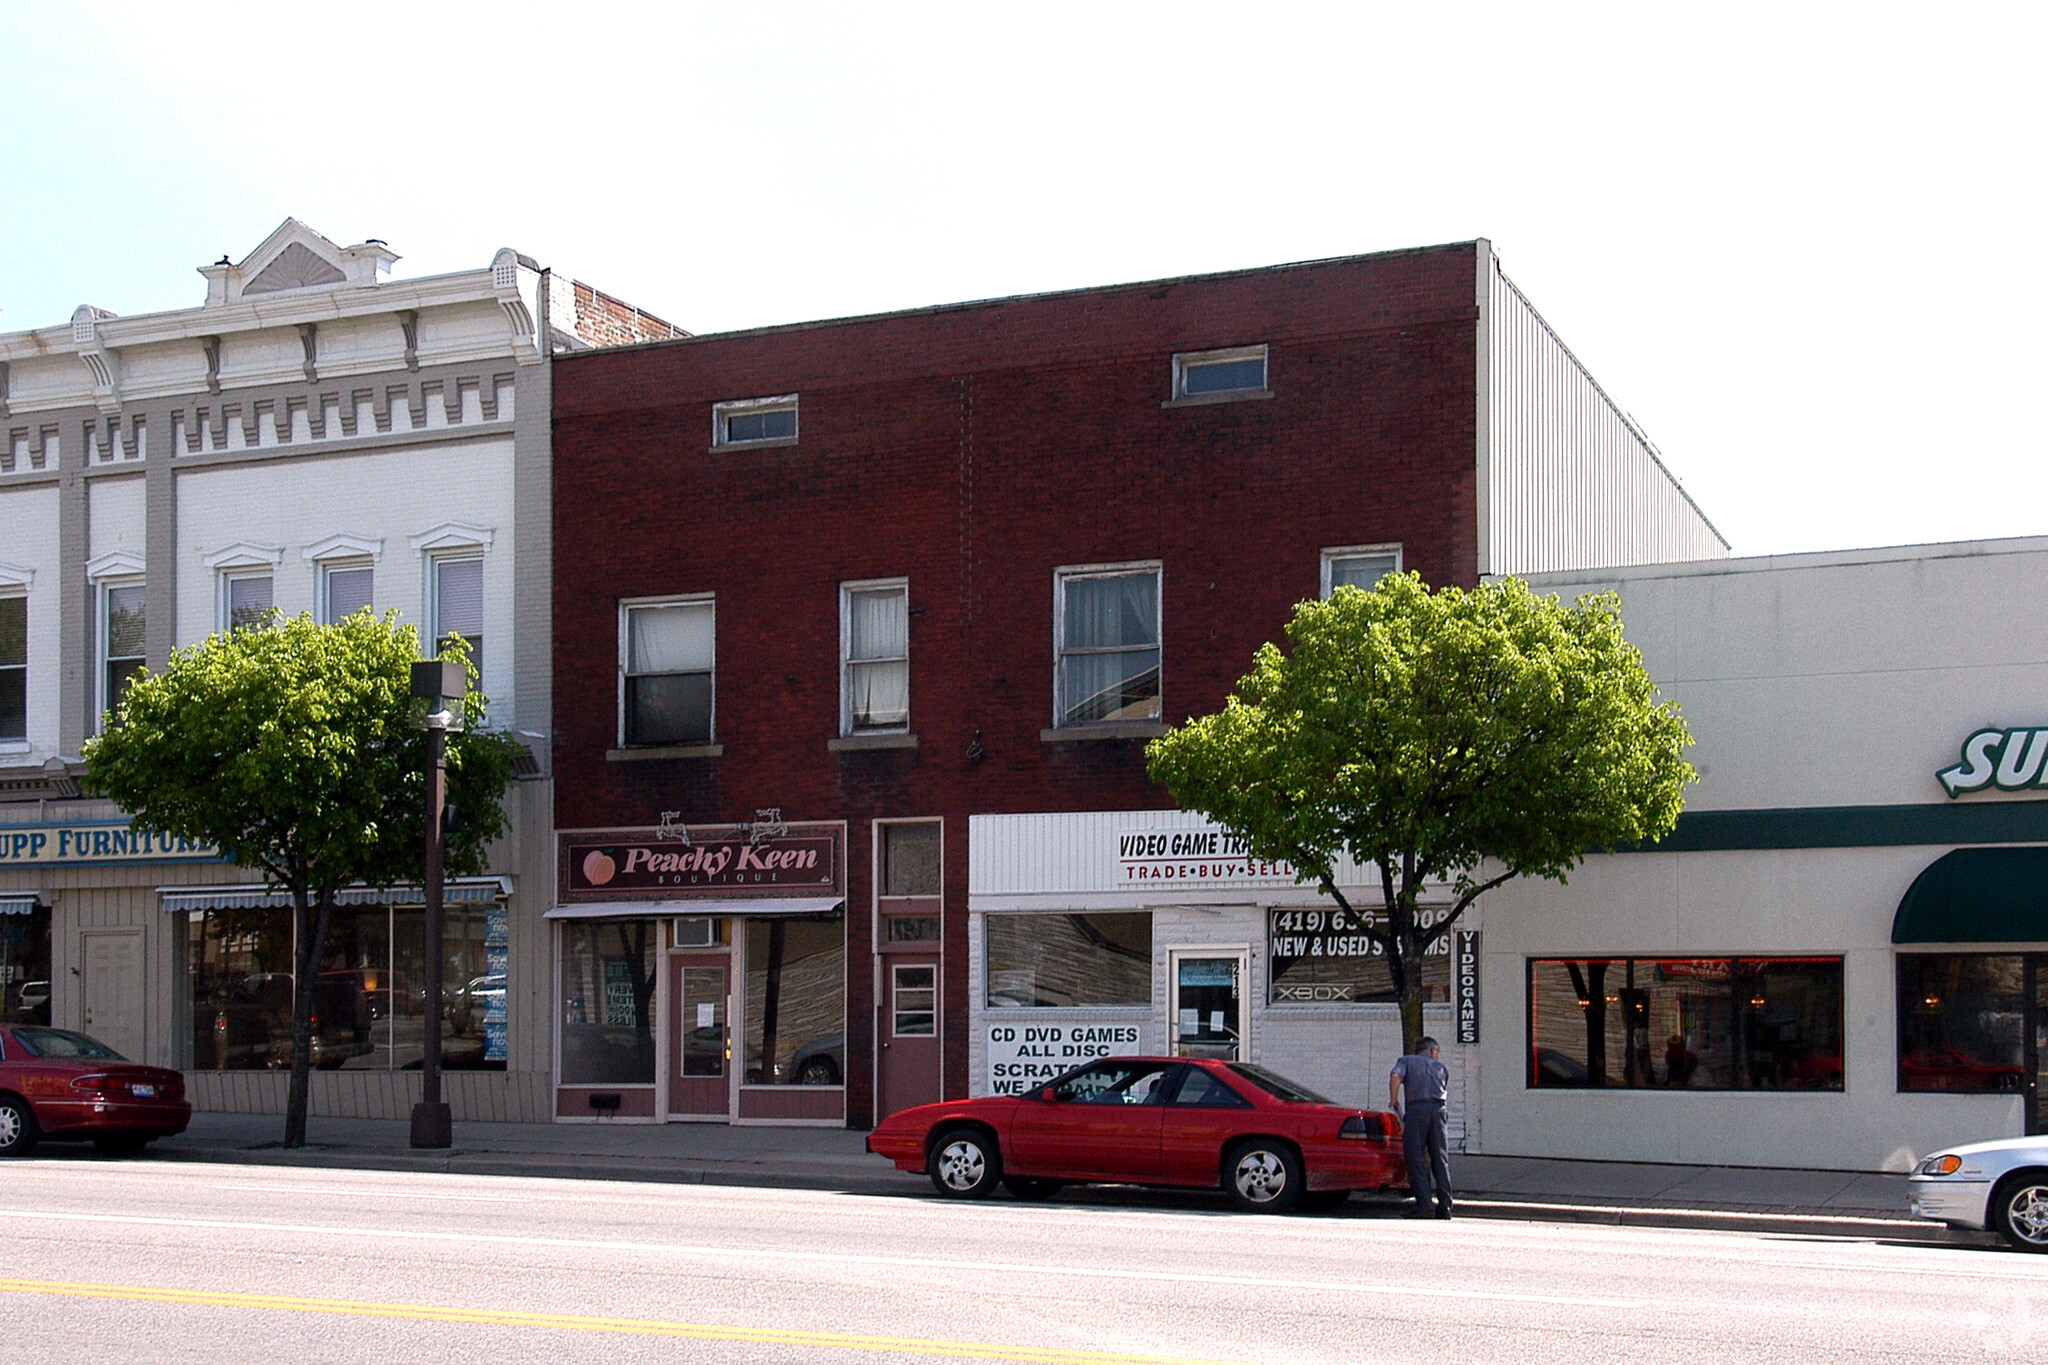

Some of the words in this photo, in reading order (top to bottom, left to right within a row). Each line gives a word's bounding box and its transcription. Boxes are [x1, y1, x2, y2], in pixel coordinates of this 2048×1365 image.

[1938, 729, 2048, 795] SU
[1120, 834, 1167, 857] VIDEO
[1171, 833, 1218, 856] GAME
[621, 845, 732, 876] Peachy
[735, 844, 819, 870] Keen
[658, 872, 778, 884] BOUTIQUE
[1127, 866, 1187, 879] TRADE
[1199, 864, 1236, 877] BUY
[1247, 862, 1293, 876] SELL
[1272, 911, 1326, 932] (419)
[1272, 937, 1308, 957] NEW
[1311, 937, 1323, 957] &
[1327, 936, 1370, 956] USED
[1279, 986, 1351, 1000] XBOX
[1461, 931, 1475, 1042] VIDEOGAMES
[991, 1028, 1016, 1042] CD
[1025, 1028, 1062, 1042] DVD
[1071, 1027, 1138, 1042] GAMES
[1017, 1045, 1056, 1057] ALL
[1062, 1044, 1110, 1057] DISC
[993, 1080, 1024, 1094] WE
